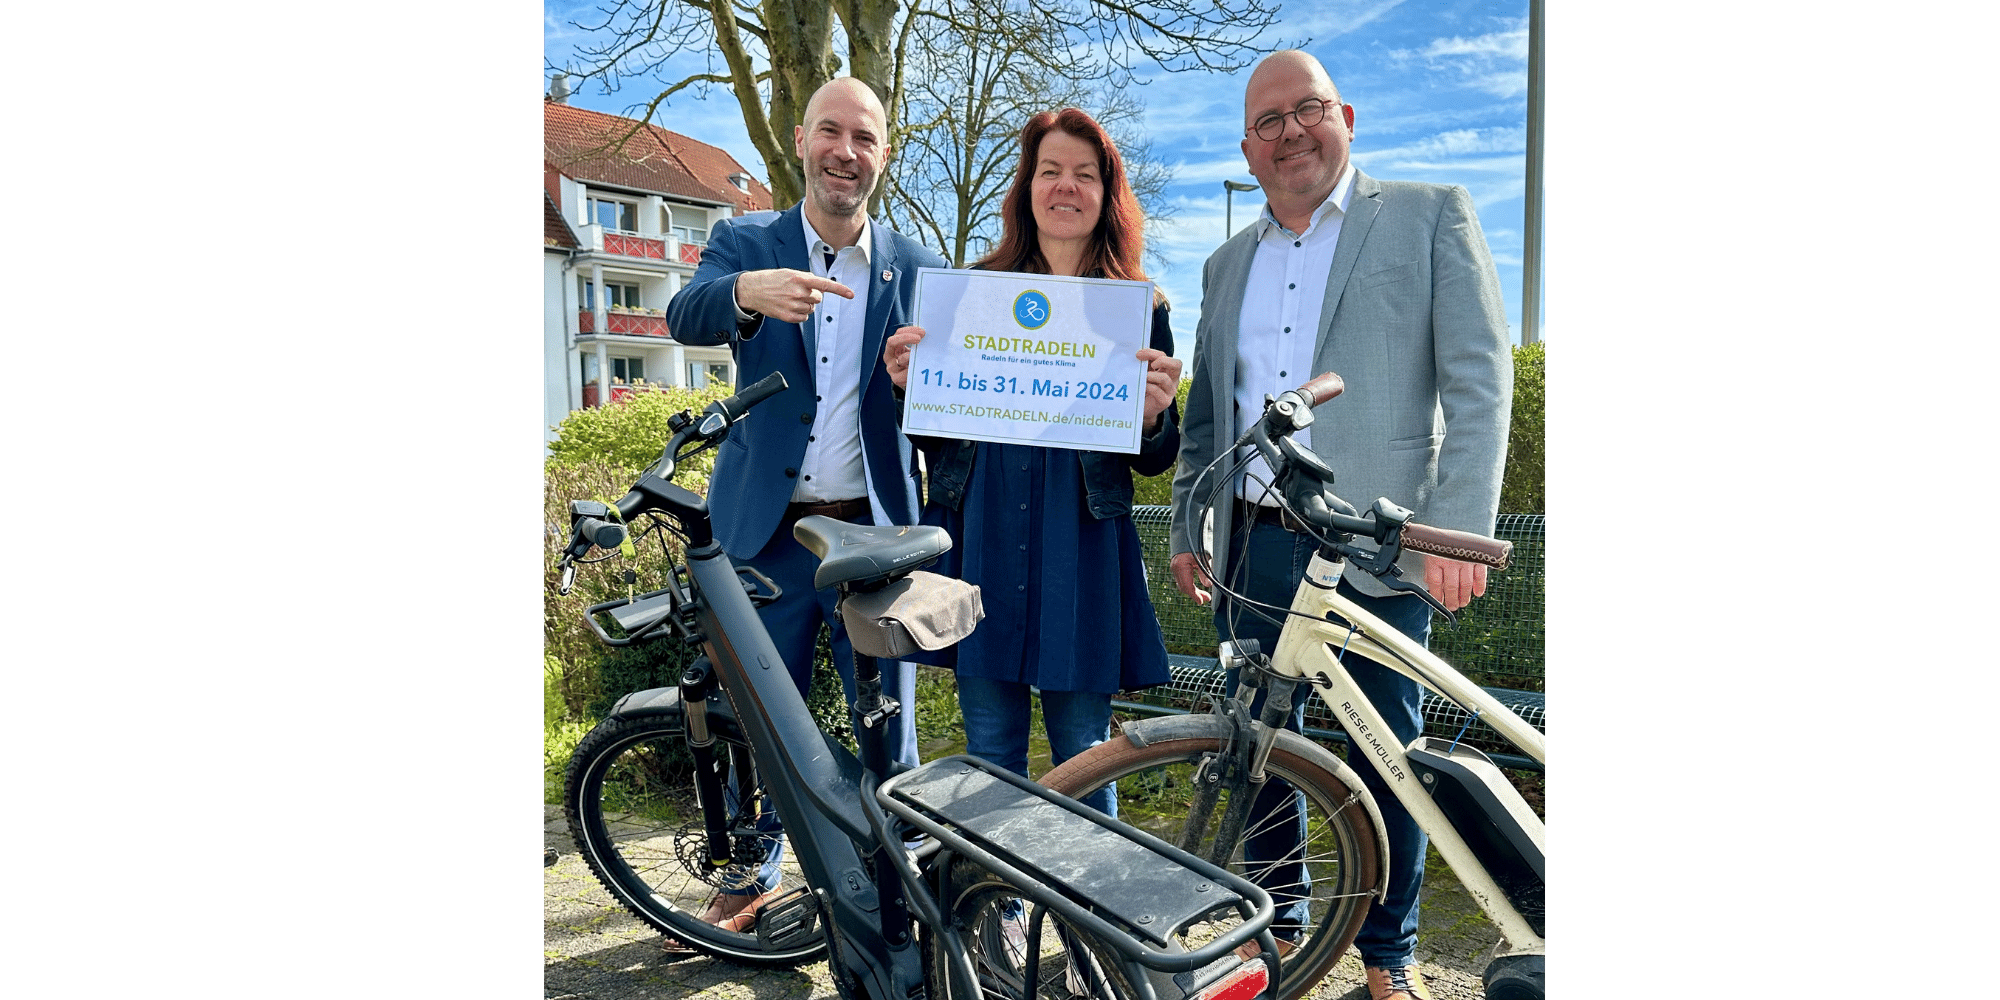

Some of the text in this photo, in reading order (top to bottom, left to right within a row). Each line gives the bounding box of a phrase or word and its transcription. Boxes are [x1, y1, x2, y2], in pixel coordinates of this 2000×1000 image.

[963, 334, 1096, 358] STADTRADELN
[981, 354, 1006, 362] Radeln
[920, 368, 1129, 401] 11. bis 31. Mai 2024
[911, 402, 1133, 429] www.STADTRADELN.de/nidderau
